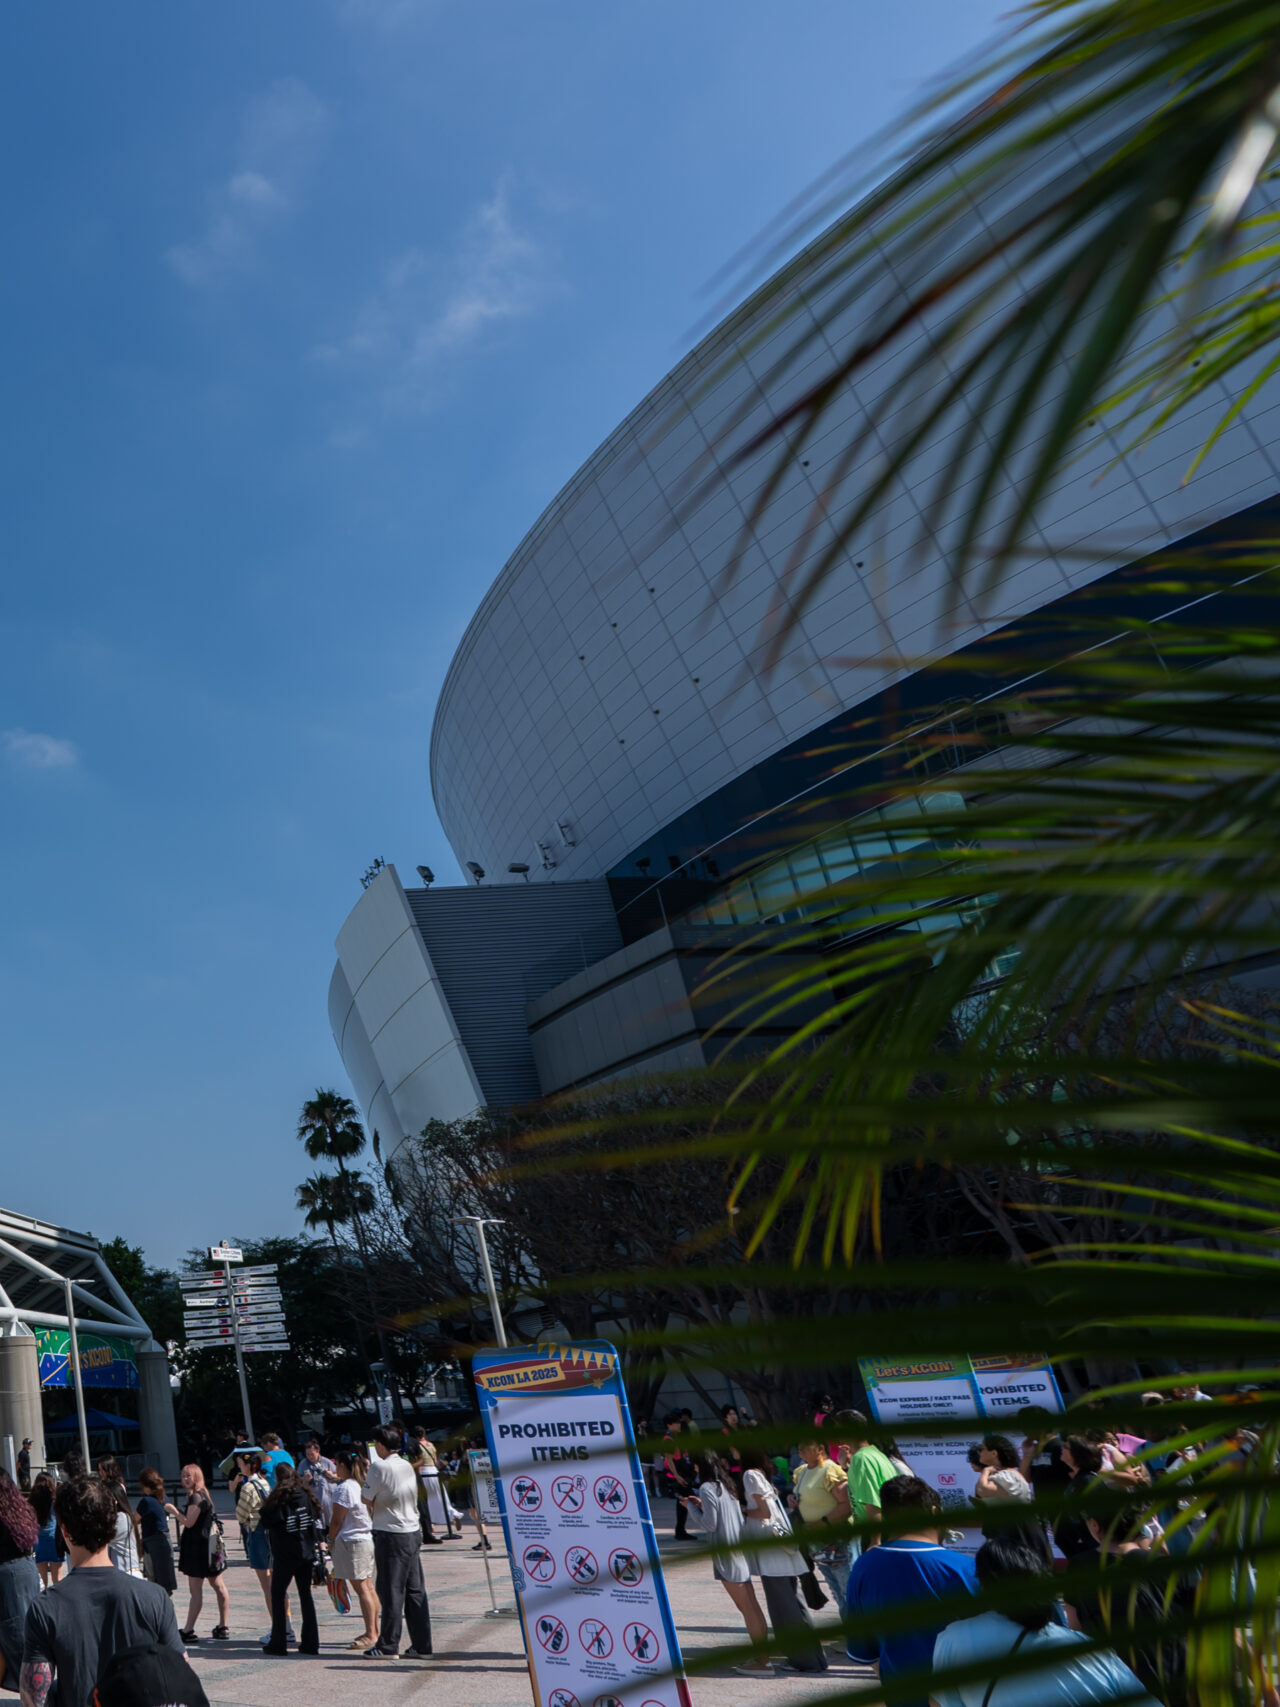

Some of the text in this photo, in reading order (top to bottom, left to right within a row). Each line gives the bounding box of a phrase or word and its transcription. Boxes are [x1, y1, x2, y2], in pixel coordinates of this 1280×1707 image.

[487, 1366, 558, 1388] KCON LA 2025
[874, 1361, 955, 1379] Let's KCON!
[979, 1384, 1046, 1396] ROHIBITED
[990, 1396, 1031, 1406] ITEMS
[498, 1420, 615, 1438] PROHIBITED
[531, 1445, 590, 1462] ITEMS
